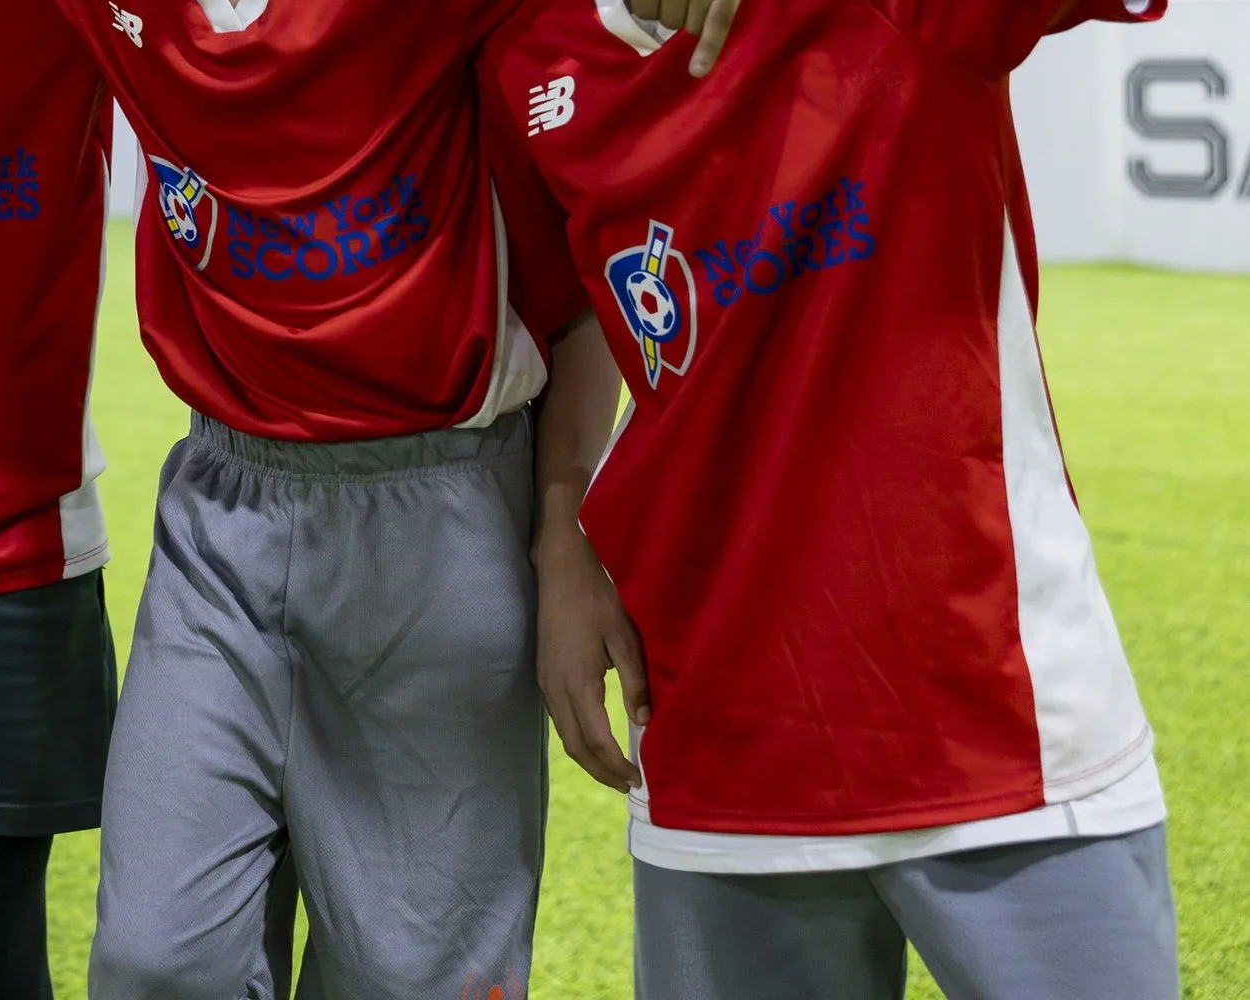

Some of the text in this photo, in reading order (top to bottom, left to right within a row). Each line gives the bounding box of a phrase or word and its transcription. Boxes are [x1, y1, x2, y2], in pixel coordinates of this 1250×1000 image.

[1124, 57, 1250, 201] S
[225, 174, 417, 238] New York
[768, 177, 866, 239] York
[228, 203, 430, 281] SCORES
